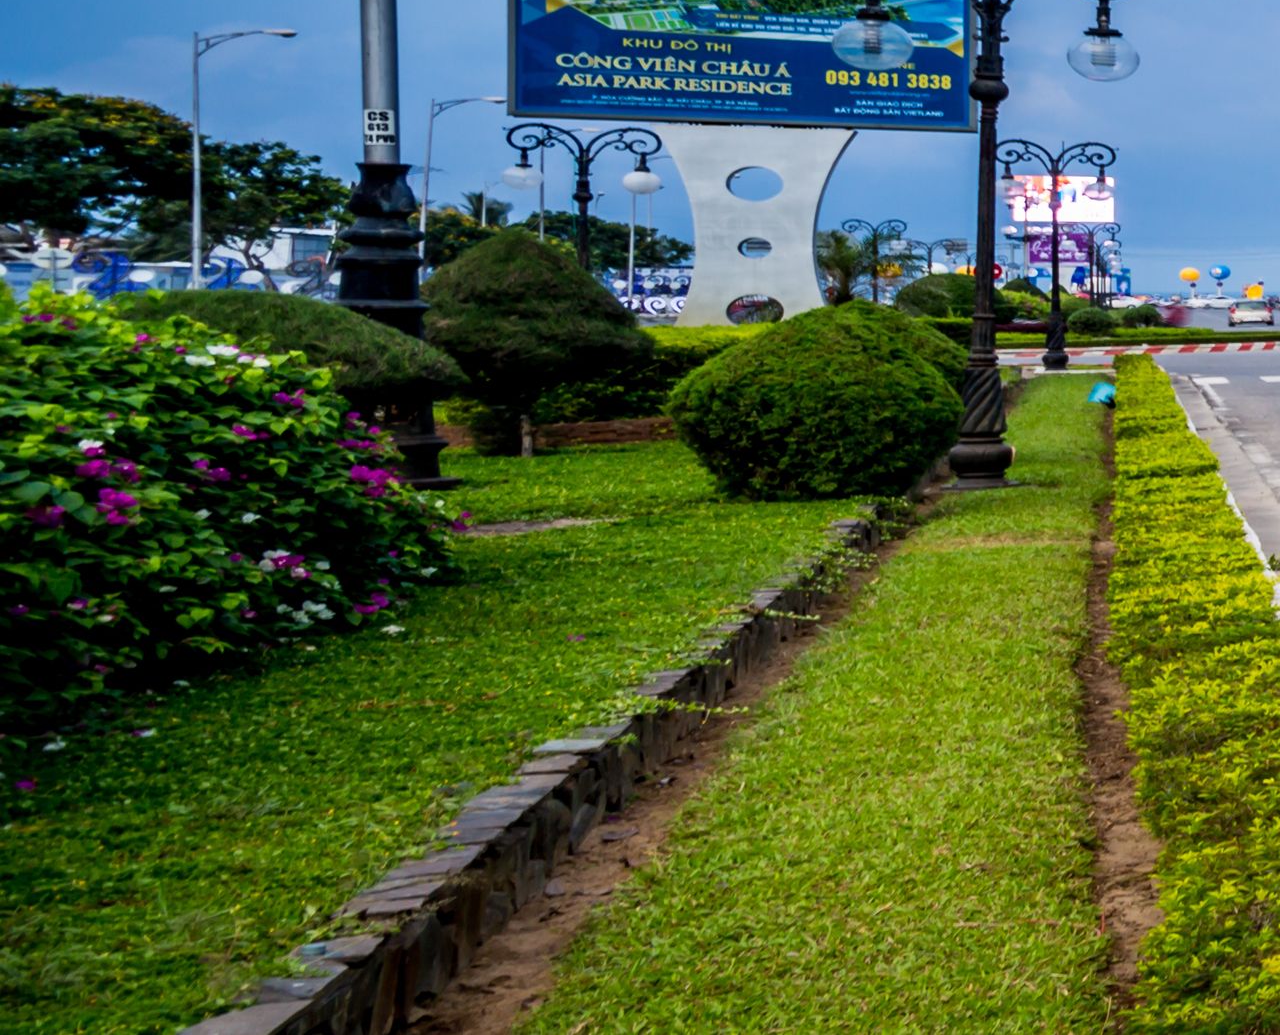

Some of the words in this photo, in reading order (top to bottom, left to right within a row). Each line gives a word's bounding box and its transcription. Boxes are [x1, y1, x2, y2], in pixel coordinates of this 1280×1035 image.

[622, 38, 663, 49] KHU
[706, 42, 732, 54] THỊ
[556, 52, 631, 70] CÔNG
[636, 56, 696, 74] VIÊN
[702, 58, 770, 76] CHÂU
[774, 62, 792, 78] Á
[556, 73, 608, 88] ASIA
[612, 74, 670, 91] PARK
[673, 78, 792, 96] RESIDENCE
[826, 70, 860, 86] 093
[867, 72, 898, 87] 481
[906, 74, 952, 90] 3838
[367, 111, 389, 121] CS
